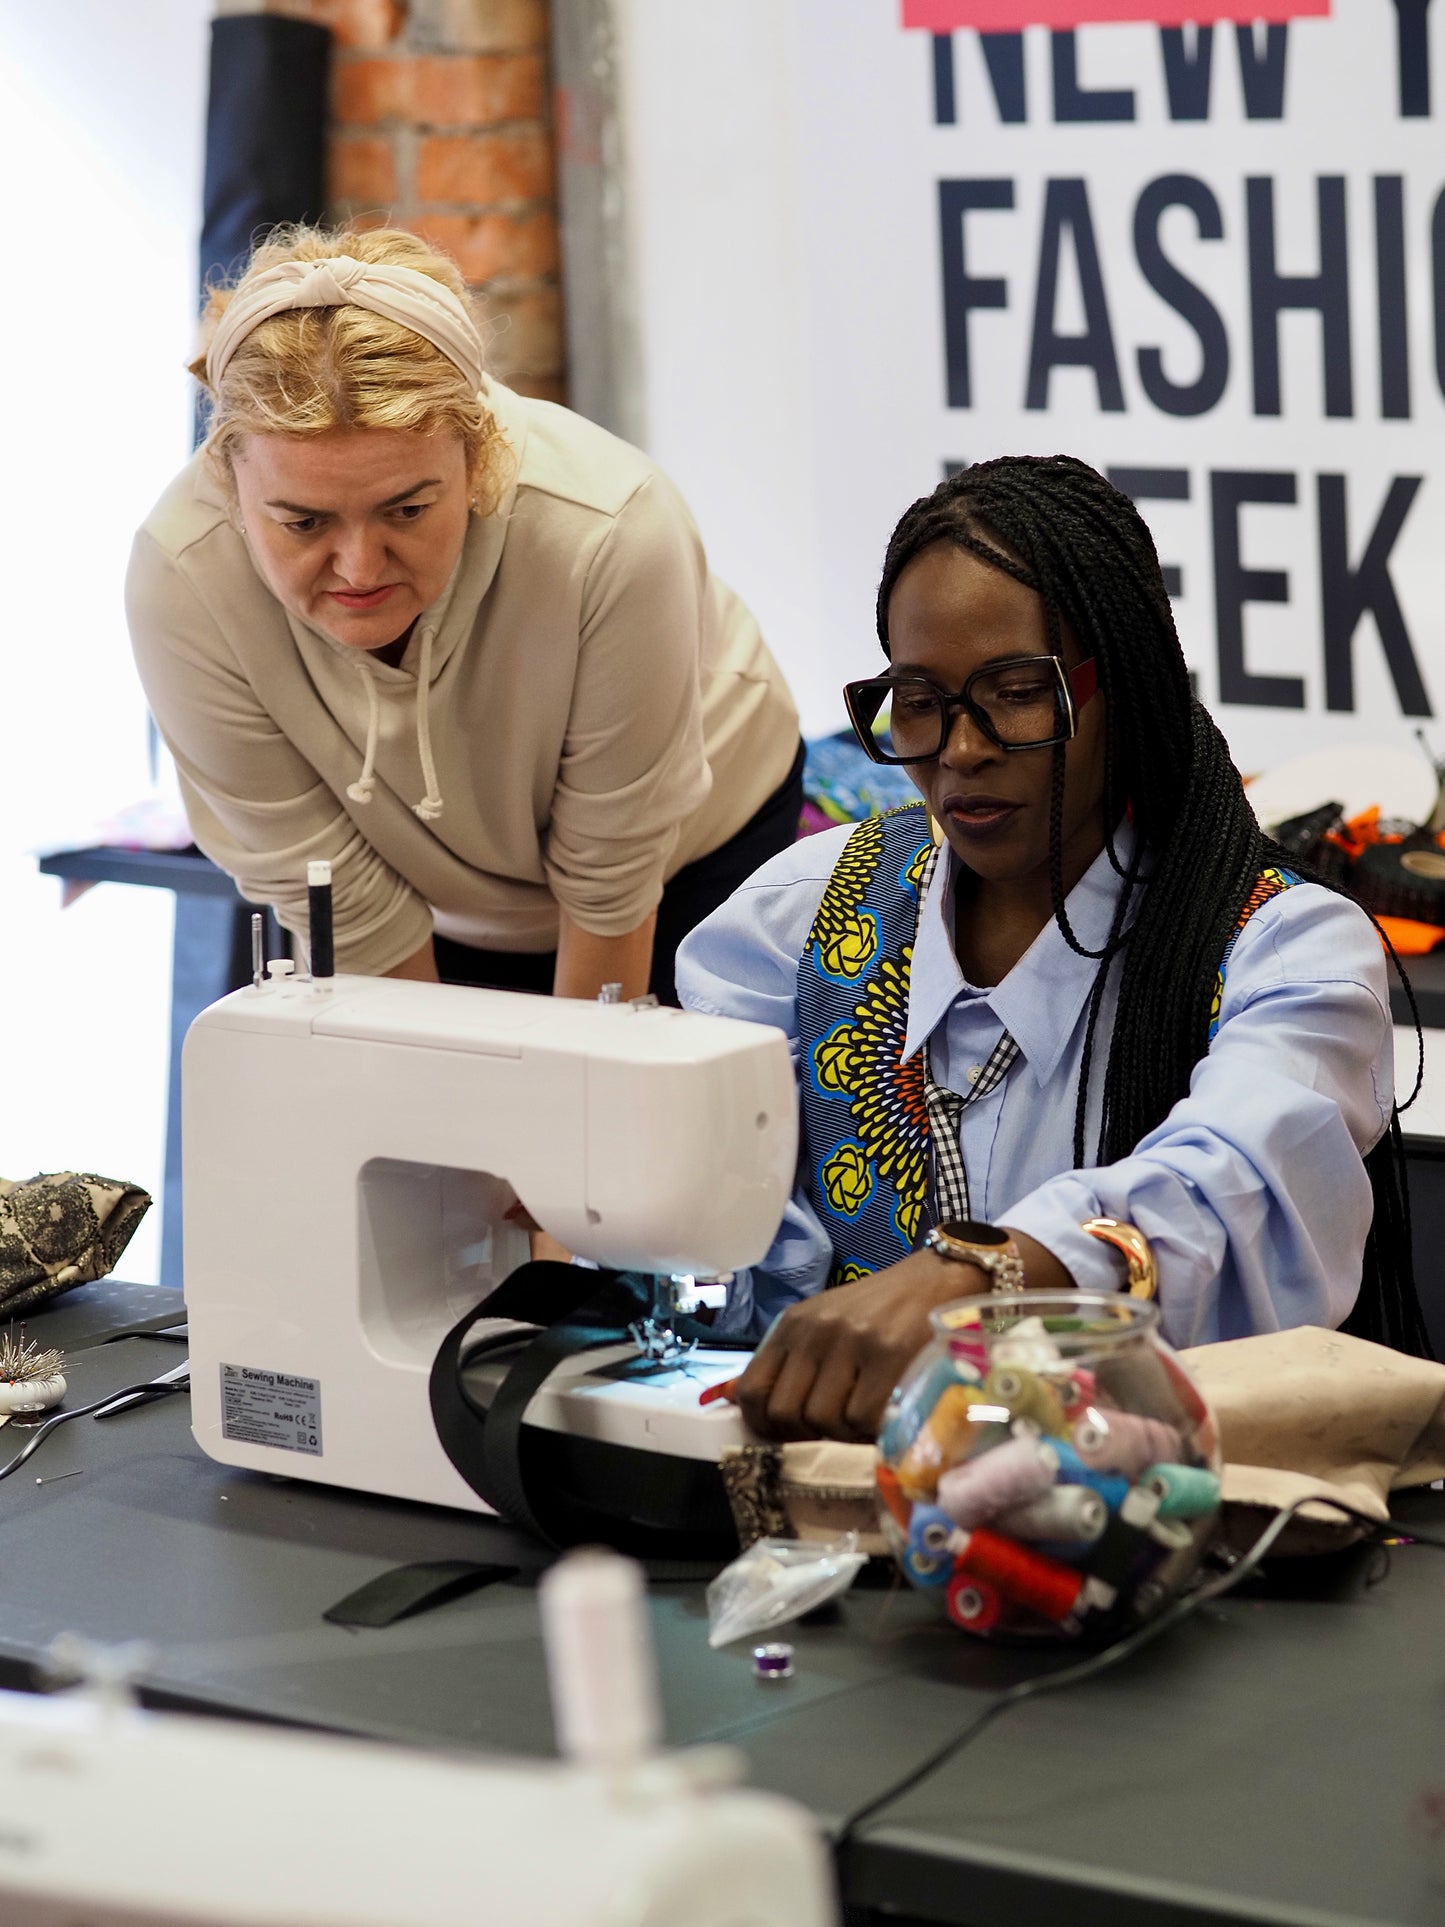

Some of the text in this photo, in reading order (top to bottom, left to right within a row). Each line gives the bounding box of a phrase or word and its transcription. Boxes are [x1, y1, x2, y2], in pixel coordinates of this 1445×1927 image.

[937, 172, 1445, 420] FASHI
[943, 460, 1434, 718] EK
[242, 1368, 274, 1386] Sewing
[276, 1375, 314, 1391] Machine
